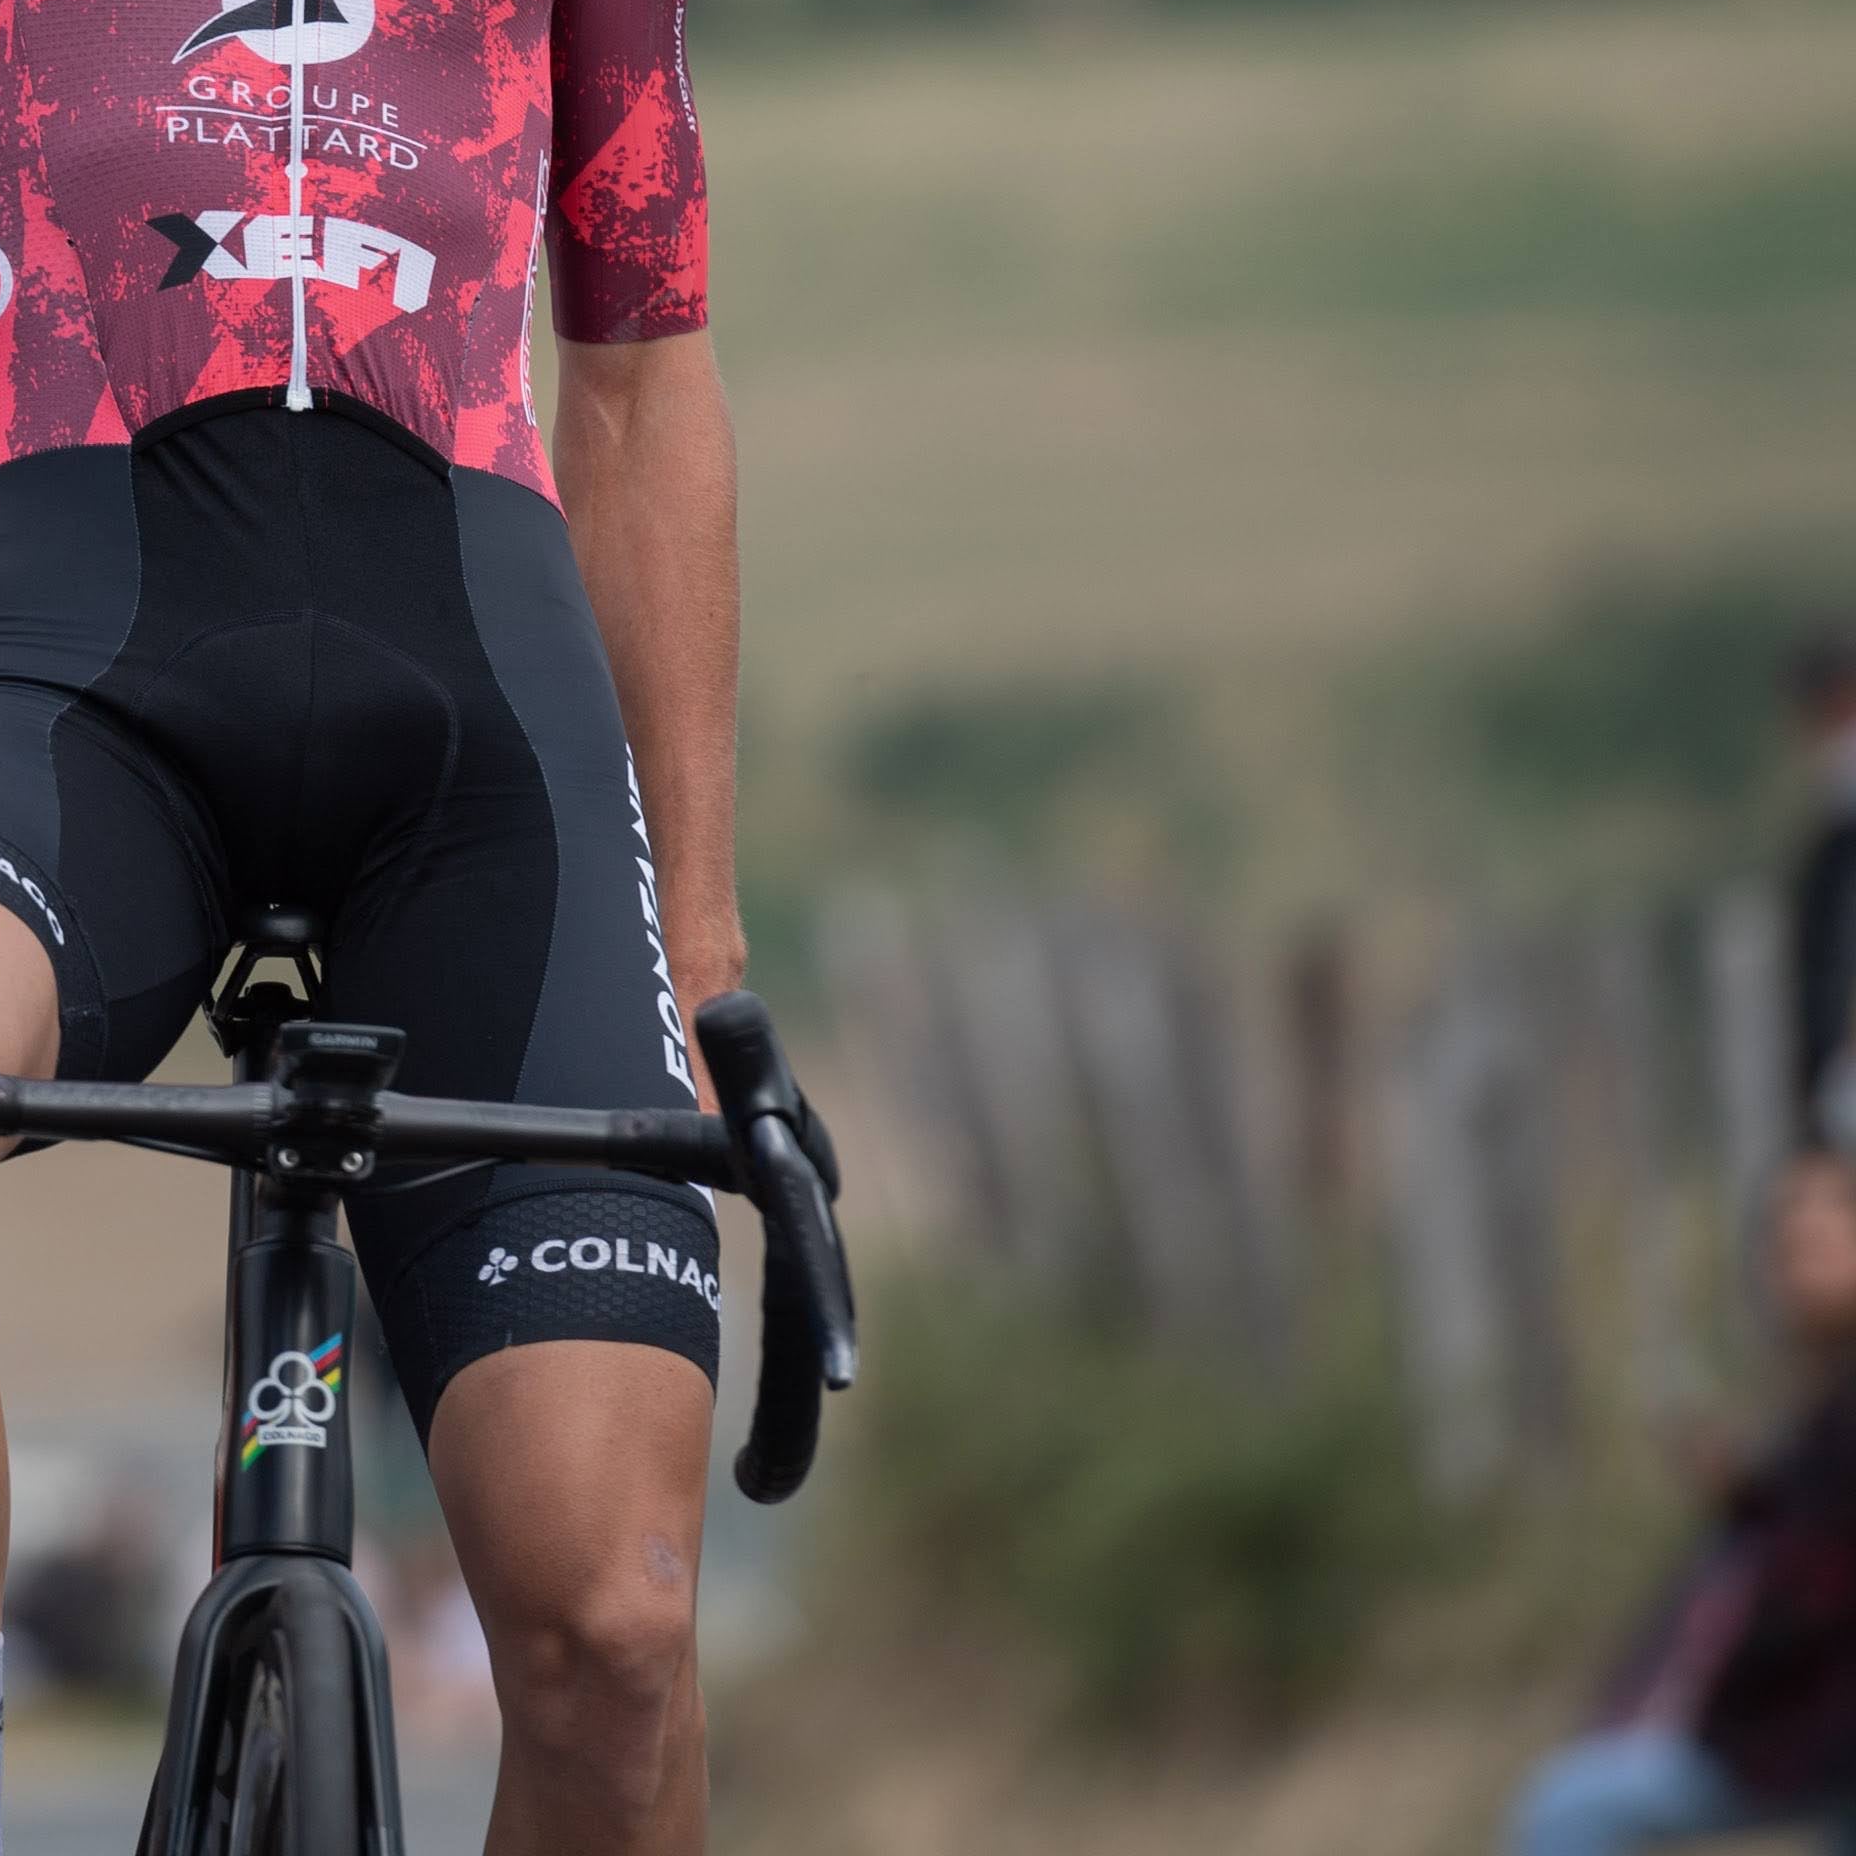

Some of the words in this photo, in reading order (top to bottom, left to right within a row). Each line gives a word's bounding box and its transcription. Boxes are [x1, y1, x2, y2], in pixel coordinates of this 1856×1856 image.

[188, 75, 400, 129] GROUPE
[167, 117, 419, 171] PLATTARD
[307, 1031, 379, 1050] GARMIN
[531, 1236, 721, 1318] COLNAG
[262, 1430, 321, 1443] COLNAGO
